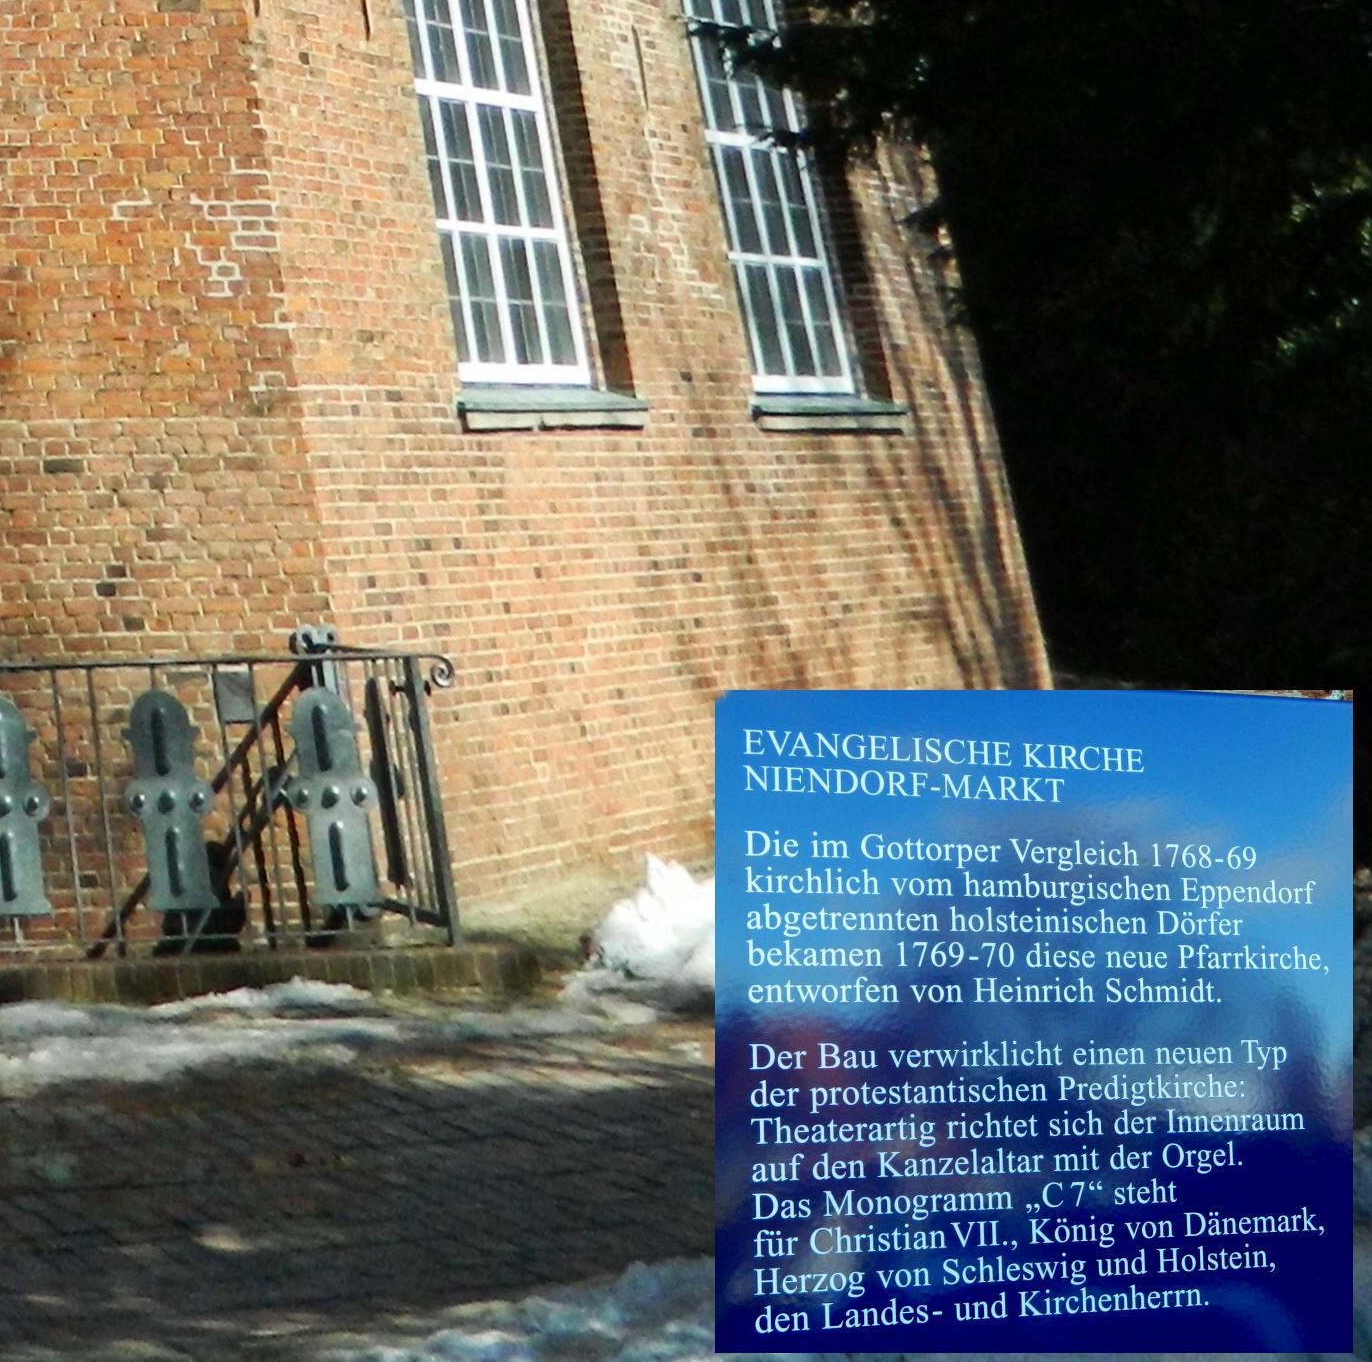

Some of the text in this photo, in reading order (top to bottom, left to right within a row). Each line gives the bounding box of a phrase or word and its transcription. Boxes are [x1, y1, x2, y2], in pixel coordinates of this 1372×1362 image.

[743, 729, 1144, 773] EVANGELISCHE KIRCHE
[743, 765, 1064, 802] NIENDORF-MARKT
[744, 830, 1256, 871] Die im Gottorper Vergleich 1768-69
[745, 866, 1316, 909] kirchlich vom hamburgischen Eppendorf
[747, 903, 1243, 937] abgetrennten holsteinischen Dörfer
[746, 939, 1328, 974] bekamen 1769-70 diese neue Pfarrkirche,
[748, 976, 1221, 1003] entworfen von Heinrich Schmidt.
[749, 1040, 1287, 1070] Der Bau verwirklicht einen neuen Typ
[750, 1073, 1244, 1114] der protestantischen Predigtkirche:
[751, 1109, 1306, 1147] Theaterartig richtet sich der Innenraum
[752, 1140, 1242, 1182] auf den Kanzelaltar mit der Orgel.
[752, 1193, 811, 1220] Das
[822, 1190, 1013, 1221] Monogramm
[1114, 1178, 1177, 1205] steht
[753, 1206, 1324, 1257] für Christian VII., König von Dänemark,
[754, 1243, 1275, 1298] Herzog von Schleswig und Holstein,
[755, 1284, 1209, 1333] den Landes- und Kirchenherrn.
